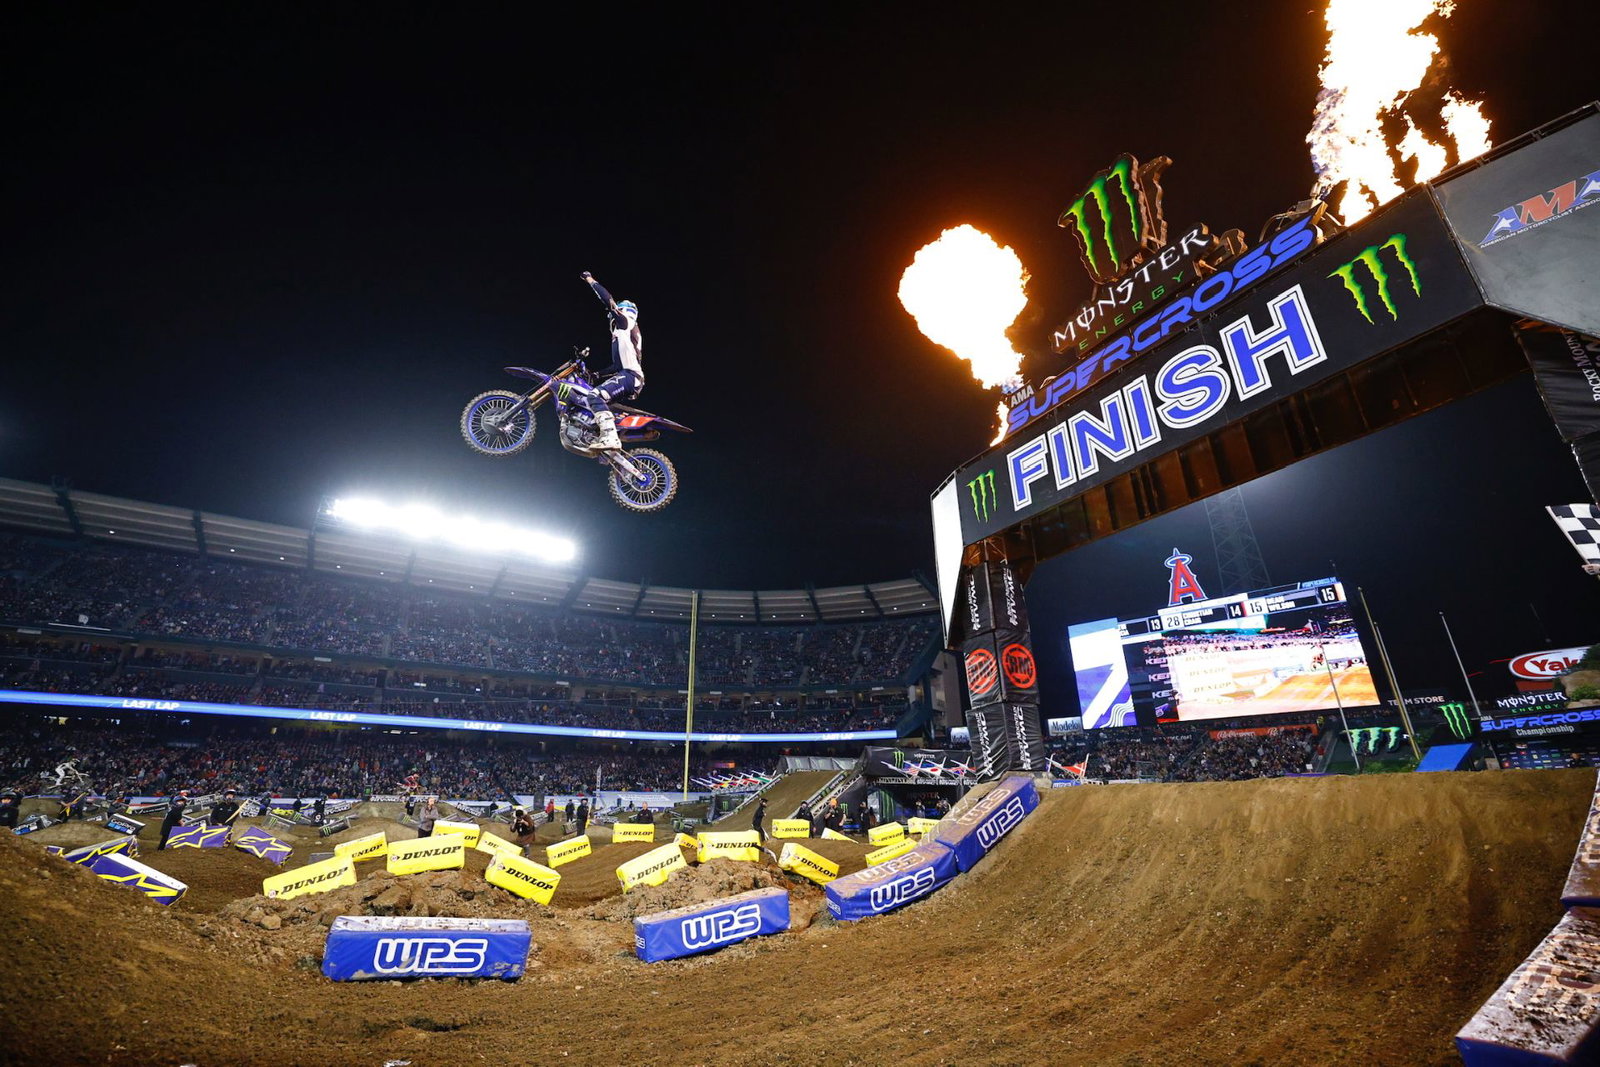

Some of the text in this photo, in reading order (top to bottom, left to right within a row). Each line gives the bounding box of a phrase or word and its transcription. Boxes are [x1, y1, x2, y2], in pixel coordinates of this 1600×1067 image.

[1480, 231, 1517, 249] AMERICAN
[1517, 208, 1573, 234] MOTORCYCLIST
[1053, 229, 1209, 348] MONSTER
[1079, 271, 1184, 350] ENERGY
[1007, 216, 1315, 433] SUPERCROSS
[1006, 283, 1328, 512] FINISH
[1010, 385, 1035, 407] AMA
[1321, 587, 1335, 601] 15
[1230, 605, 1241, 617] 14
[1250, 601, 1263, 613] 15
[1151, 619, 1161, 630] 13
[1167, 616, 1180, 627] 28
[122, 699, 180, 710] LAST LAP
[1387, 695, 1445, 706] TEM STORE
[1497, 691, 1567, 708] MONSTER
[310, 712, 357, 721] LAST LAP
[1511, 703, 1559, 714] ENERGY
[463, 721, 502, 731] LAST LAP
[1052, 720, 1079, 731] Modelo
[1480, 710, 1600, 732] SUPERCROSS
[1515, 725, 1575, 737] Championship
[976, 796, 1025, 849] WPS
[351, 843, 383, 858] UNLOP
[401, 845, 462, 861] DUNLOP
[557, 843, 589, 858] DUNLOP
[636, 854, 681, 880] DUNLOP
[799, 857, 836, 879] DUNLOP
[281, 866, 349, 895] DUNLOP
[505, 867, 554, 891] DUNLOP
[870, 866, 935, 911] WPS
[681, 903, 762, 950] WPS
[373, 938, 489, 973] WPS
